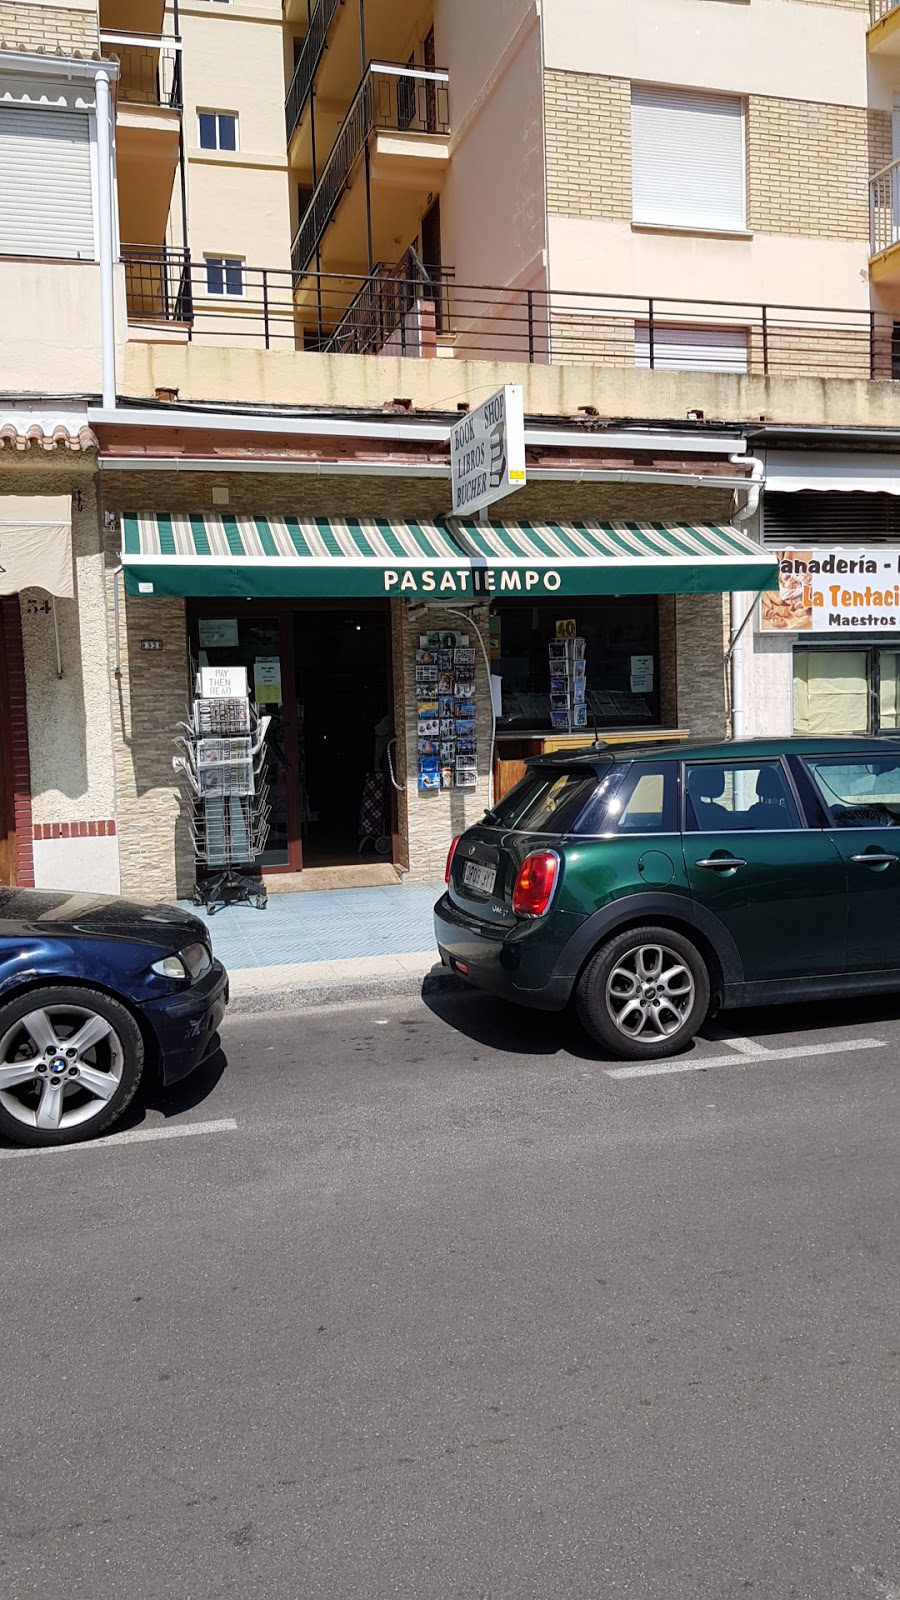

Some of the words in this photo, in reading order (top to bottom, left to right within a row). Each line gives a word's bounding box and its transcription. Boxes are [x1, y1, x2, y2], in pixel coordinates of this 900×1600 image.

[454, 417, 475, 452] BOOK
[484, 394, 504, 430] SHOP
[457, 442, 485, 479] LIBROS
[456, 472, 487, 508] BÜCHER
[778, 554, 877, 574] anadería
[384, 569, 562, 592] PASATIEMPO
[803, 585, 824, 607] La
[828, 613, 896, 627] Maestros
[209, 678, 231, 687] THEN
[215, 669, 228, 678] PAY
[210, 686, 232, 695] READ
